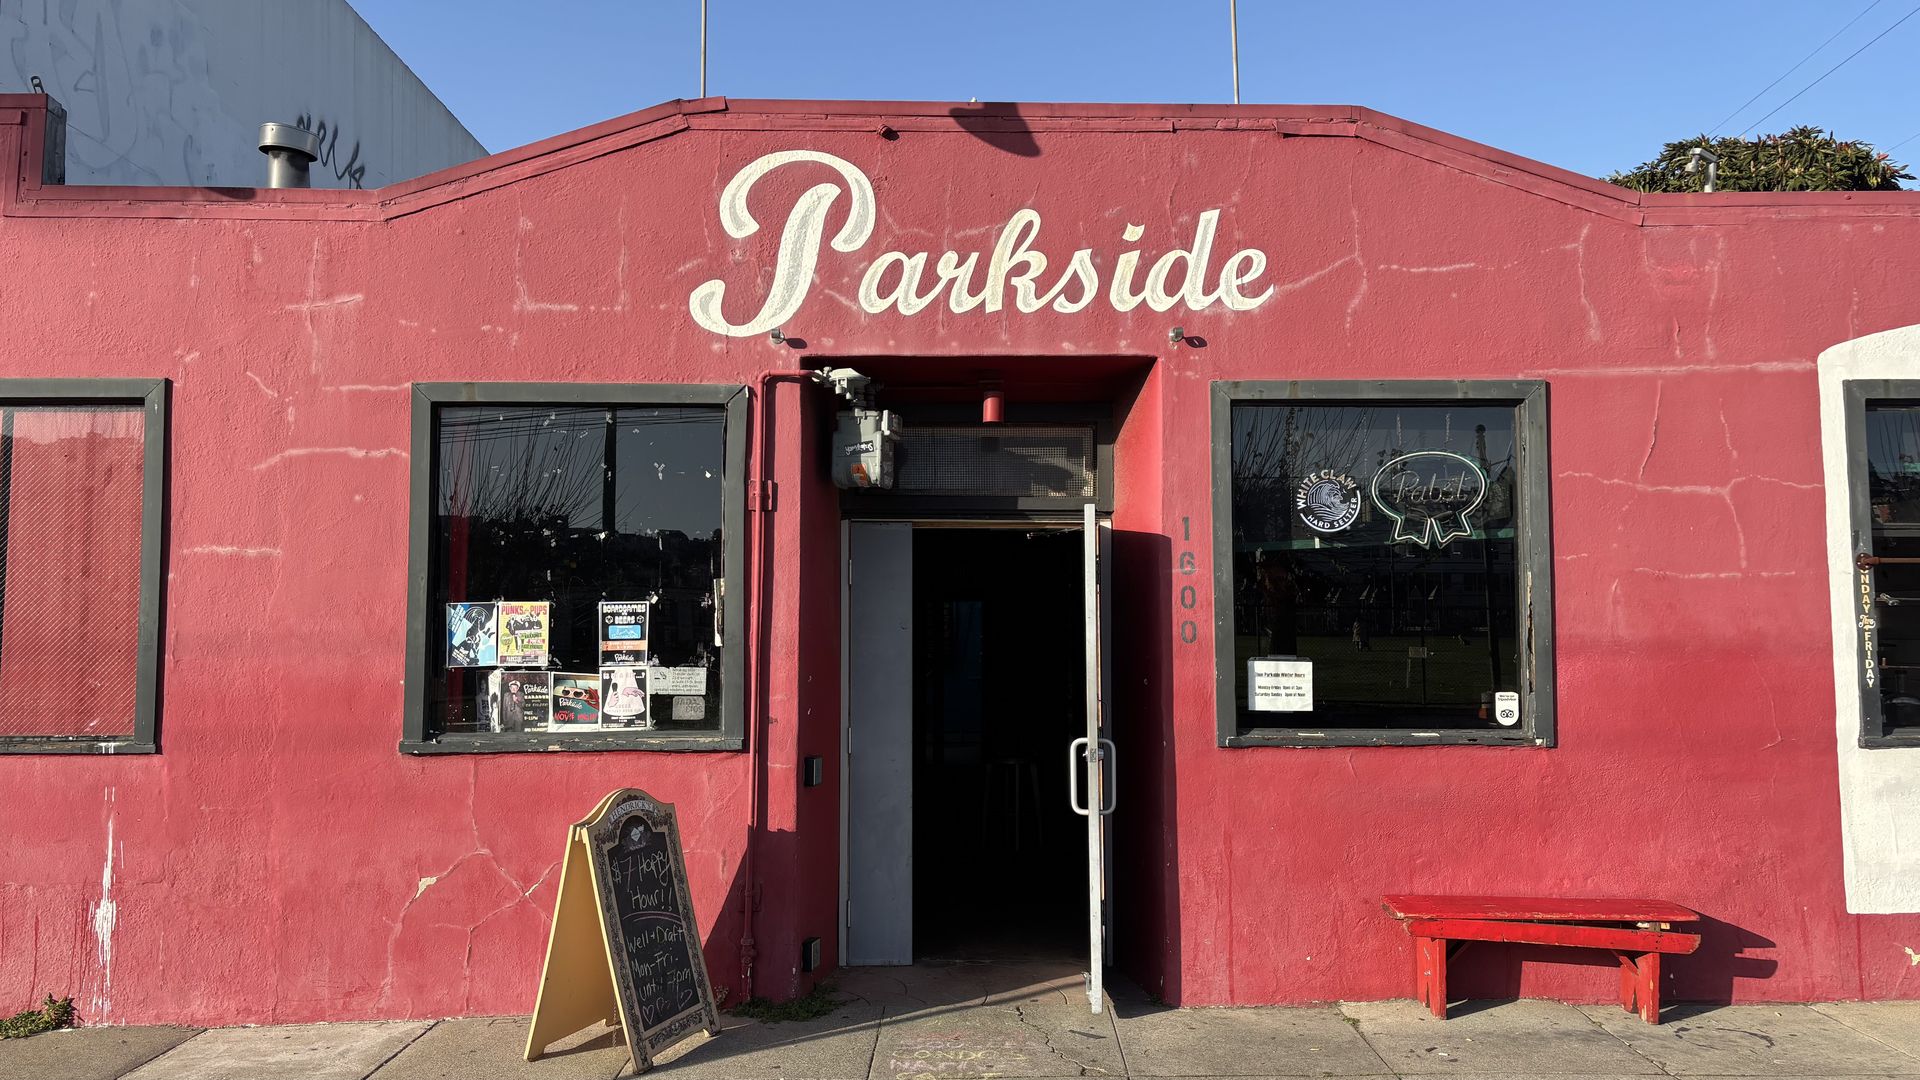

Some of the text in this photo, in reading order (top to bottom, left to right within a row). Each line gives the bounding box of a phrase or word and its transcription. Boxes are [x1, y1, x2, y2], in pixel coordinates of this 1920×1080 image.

[689, 150, 1275, 337] Parkside
[1296, 469, 1357, 510] WHITE CLAW
[1392, 470, 1472, 503] Pabst
[1307, 497, 1358, 529] HARD SELTZER
[1180, 516, 1197, 644] 1600
[501, 604, 524, 615] PUNKS
[529, 604, 548, 615] PUPS
[1864, 631, 1875, 688] FRIDAY
[523, 684, 549, 695] Parkside
[637, 850, 671, 887] Happy
